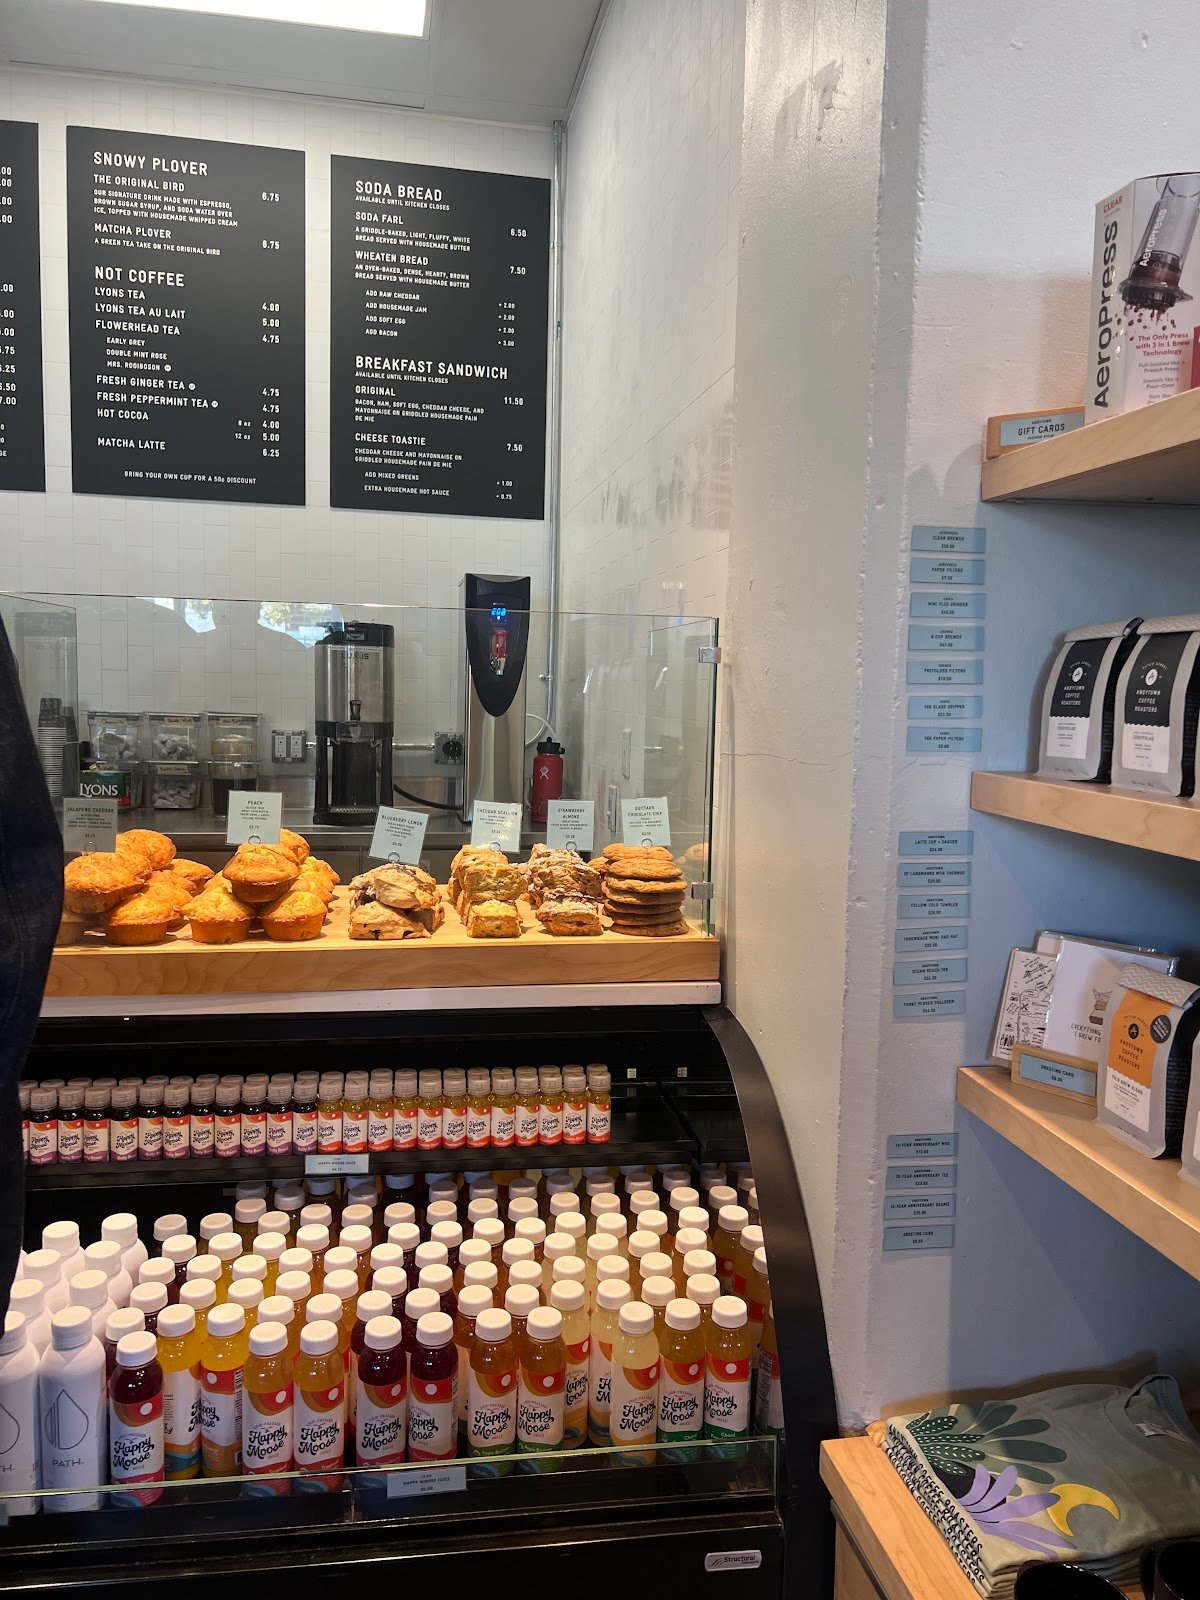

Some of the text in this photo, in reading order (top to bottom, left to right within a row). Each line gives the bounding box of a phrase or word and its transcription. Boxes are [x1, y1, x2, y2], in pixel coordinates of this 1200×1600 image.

[94, 152, 207, 176] SNOWY PLOVER
[94, 174, 184, 192] THE ORIGINAL BIRD
[356, 180, 442, 201] SODA BREAD
[262, 192, 279, 202] 6.75
[1104, 196, 1122, 212] CLEAR
[355, 211, 403, 224] SODA FARL
[95, 223, 171, 239] MATCHA PLOVER
[511, 228, 526, 237] 6.50
[1140, 208, 1166, 266] AeroPress
[262, 240, 279, 249] 6.75
[355, 250, 428, 265] WHEATEN BREAD
[95, 266, 184, 287] NOT COFFEE
[510, 266, 526, 275] 7.50
[95, 287, 145, 299] LYONS TEA
[95, 303, 185, 319] LYONS TEA AU LAIT
[262, 302, 279, 312] 4.00
[379, 303, 413, 312] HOUSEMADE
[1094, 220, 1118, 408] AeroPress
[96, 320, 180, 335] FLOWERHEAD TEA
[263, 318, 279, 327] 5.00
[262, 334, 279, 343] 4.75
[106, 349, 131, 357] DOUBLE
[356, 356, 507, 379] BREAKFAST SANDWICH
[97, 375, 185, 390] FRESH GINGER TEA
[262, 388, 279, 396] 4.75
[355, 385, 396, 396] ORIGINAL
[97, 392, 208, 408] FRESH PEPPERMINT TEA
[504, 396, 523, 405] 11.50
[97, 408, 148, 420] HOT COCOA
[262, 404, 279, 413] 4.75
[263, 420, 279, 429] 4.00
[1018, 424, 1065, 436] GIFT CARDS
[98, 437, 165, 450] MATCHA LATTE
[263, 433, 279, 441] 5.00
[355, 433, 426, 445] CHEESE TOASTIE
[263, 448, 279, 457] 6.25
[507, 443, 522, 452] 7.50
[79, 784, 118, 797] LYONS
[663, 1396, 698, 1412] Happy
[704, 1387, 737, 1410] Happy
[475, 1408, 511, 1426] Happy
[520, 1405, 554, 1424] Happy
[661, 1408, 695, 1425] Moose
[301, 1421, 340, 1441] Happy
[364, 1417, 401, 1437] Happy
[472, 1422, 508, 1439] Moose
[519, 1417, 550, 1435] Moose
[249, 1426, 287, 1445] Happy
[362, 1433, 398, 1450] Moose
[114, 1436, 155, 1458] Happy
[247, 1441, 285, 1460] Moose
[299, 1436, 337, 1455] Moose
[112, 1450, 150, 1470] Moose
[945, 1500, 982, 1549] ROASTERS
